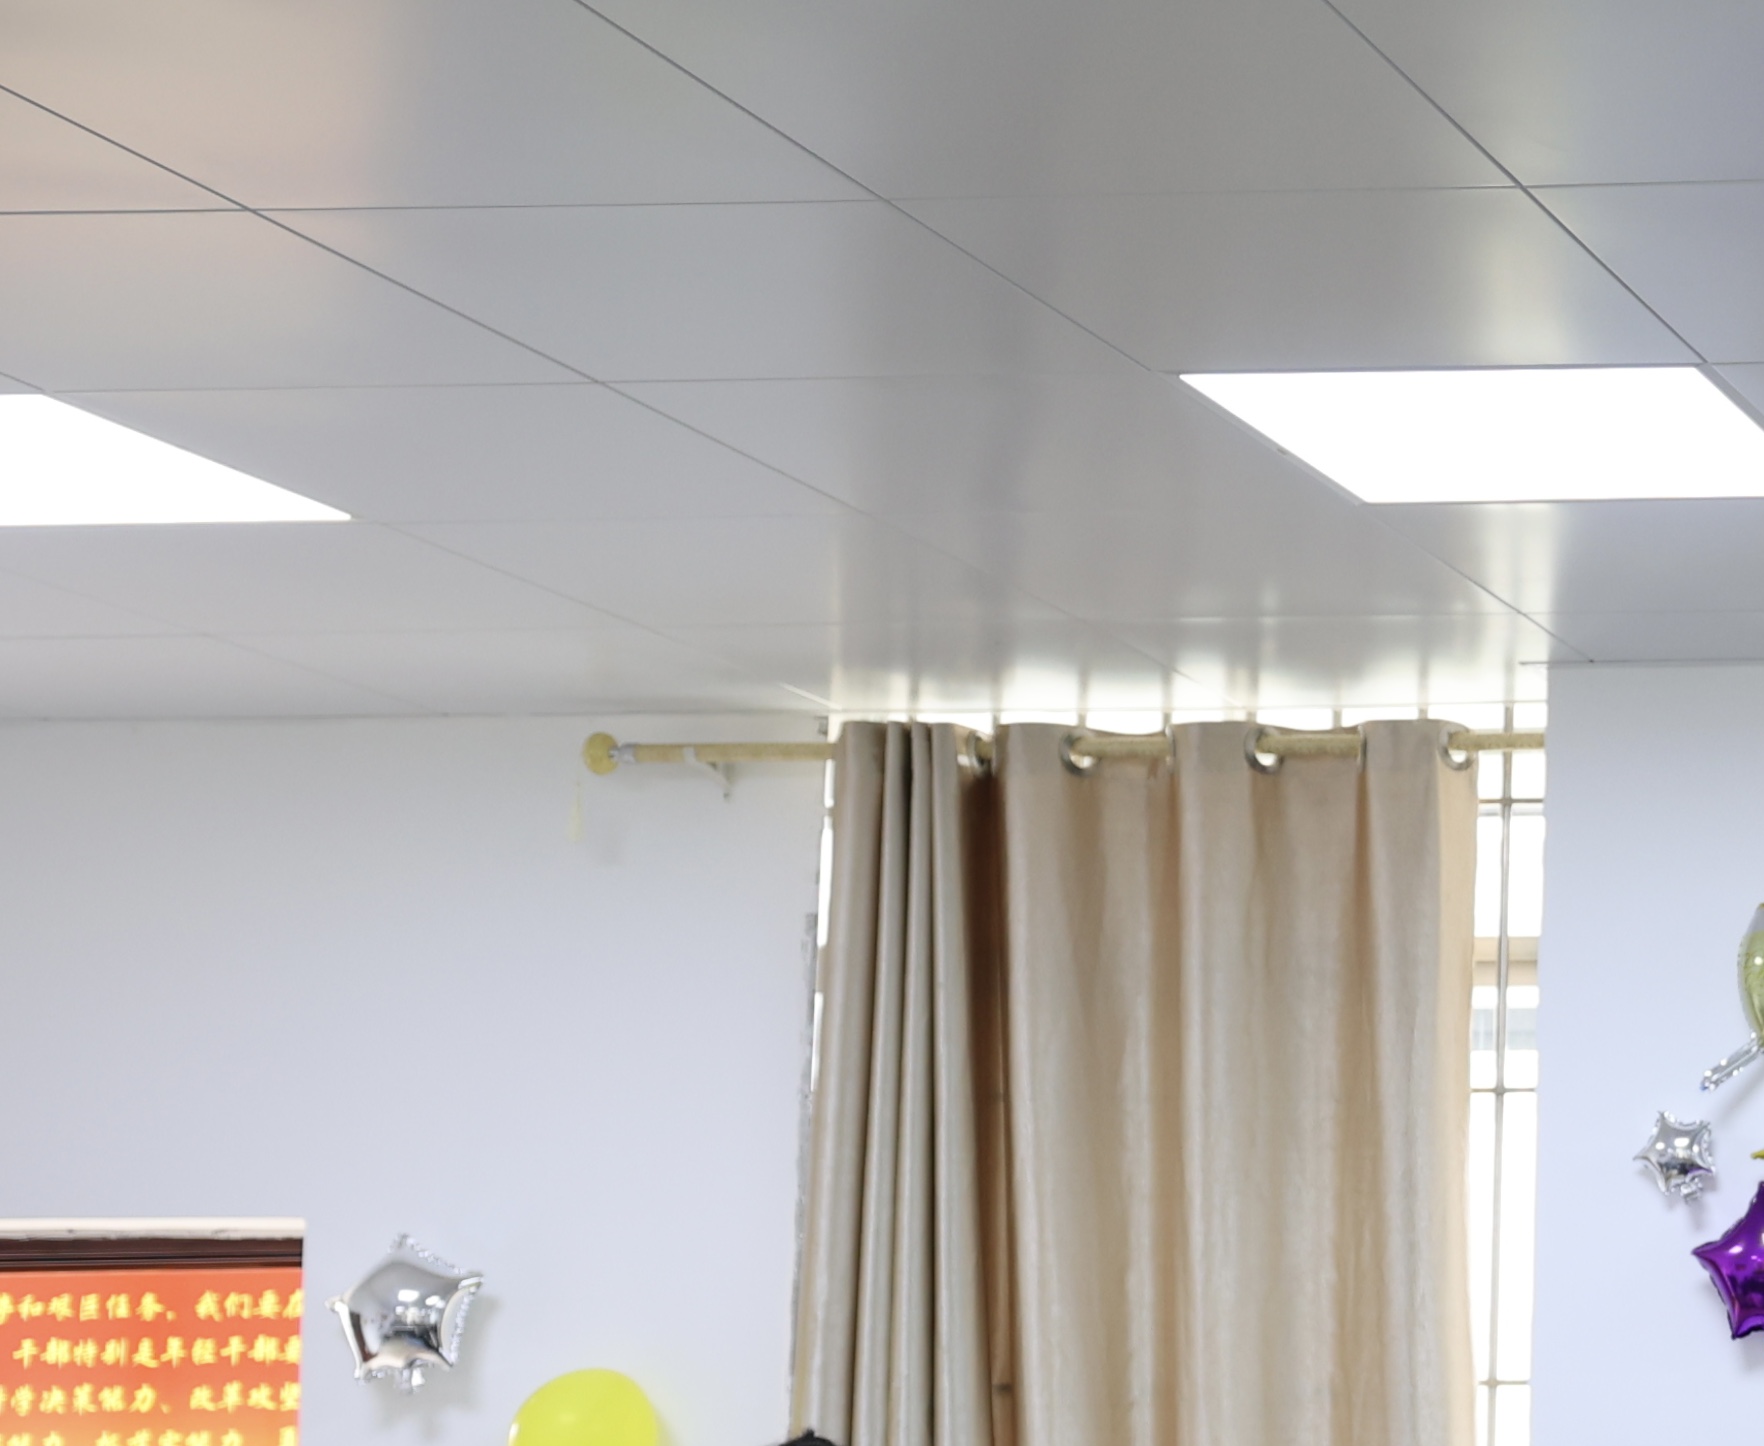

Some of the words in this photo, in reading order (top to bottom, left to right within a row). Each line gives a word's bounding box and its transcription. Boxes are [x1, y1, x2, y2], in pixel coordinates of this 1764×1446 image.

[0, 1380, 300, 1417] 学决策能力、改革攻坚
